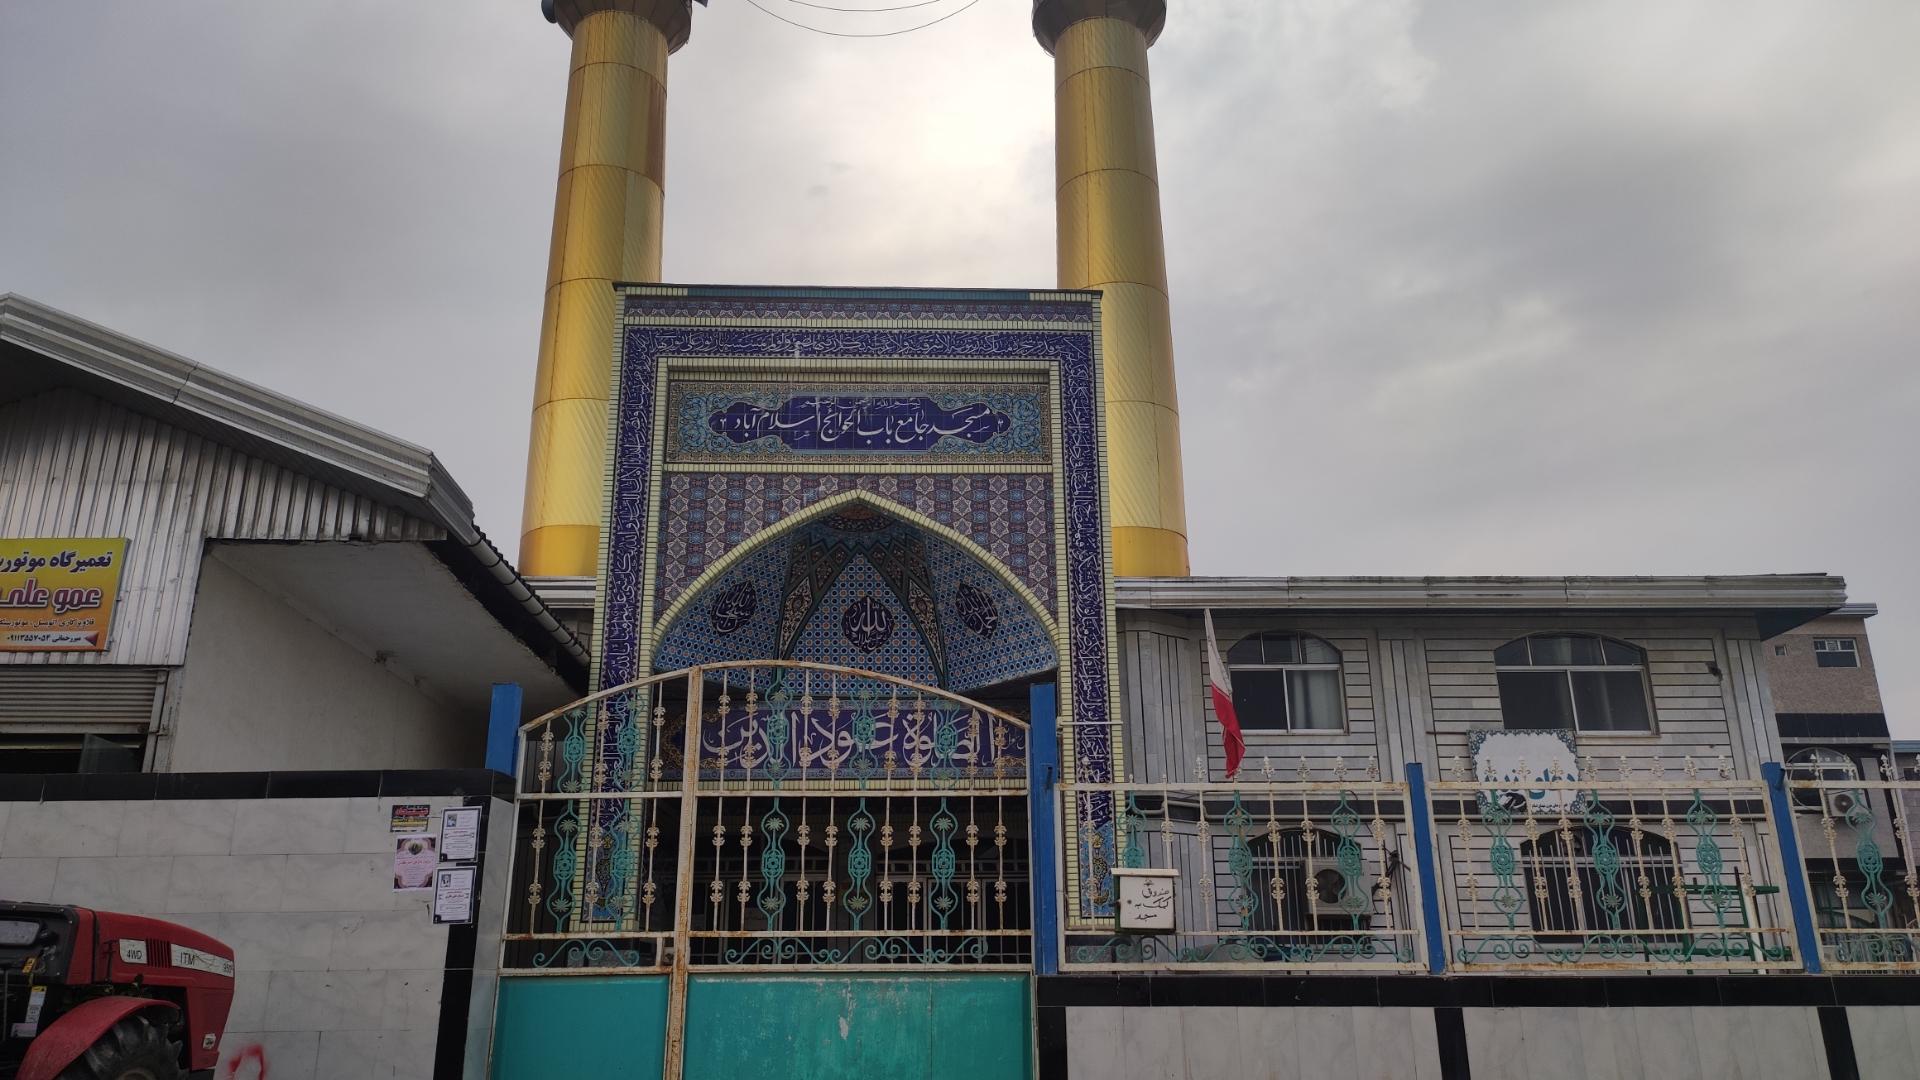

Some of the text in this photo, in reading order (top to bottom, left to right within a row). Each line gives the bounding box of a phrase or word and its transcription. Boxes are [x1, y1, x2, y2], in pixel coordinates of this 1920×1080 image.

[733, 407, 761, 437] آباد
[755, 410, 820, 438] اسلام
[855, 414, 893, 443] باب
[894, 409, 931, 443] جامع
[925, 406, 989, 437] مسجد
[50, 551, 112, 572] تعمیرگاه
[53, 588, 101, 612] عمو
[1135, 913, 1157, 922] مسجد
[126, 950, 142, 960] 4WD
[180, 952, 195, 965] ITM
